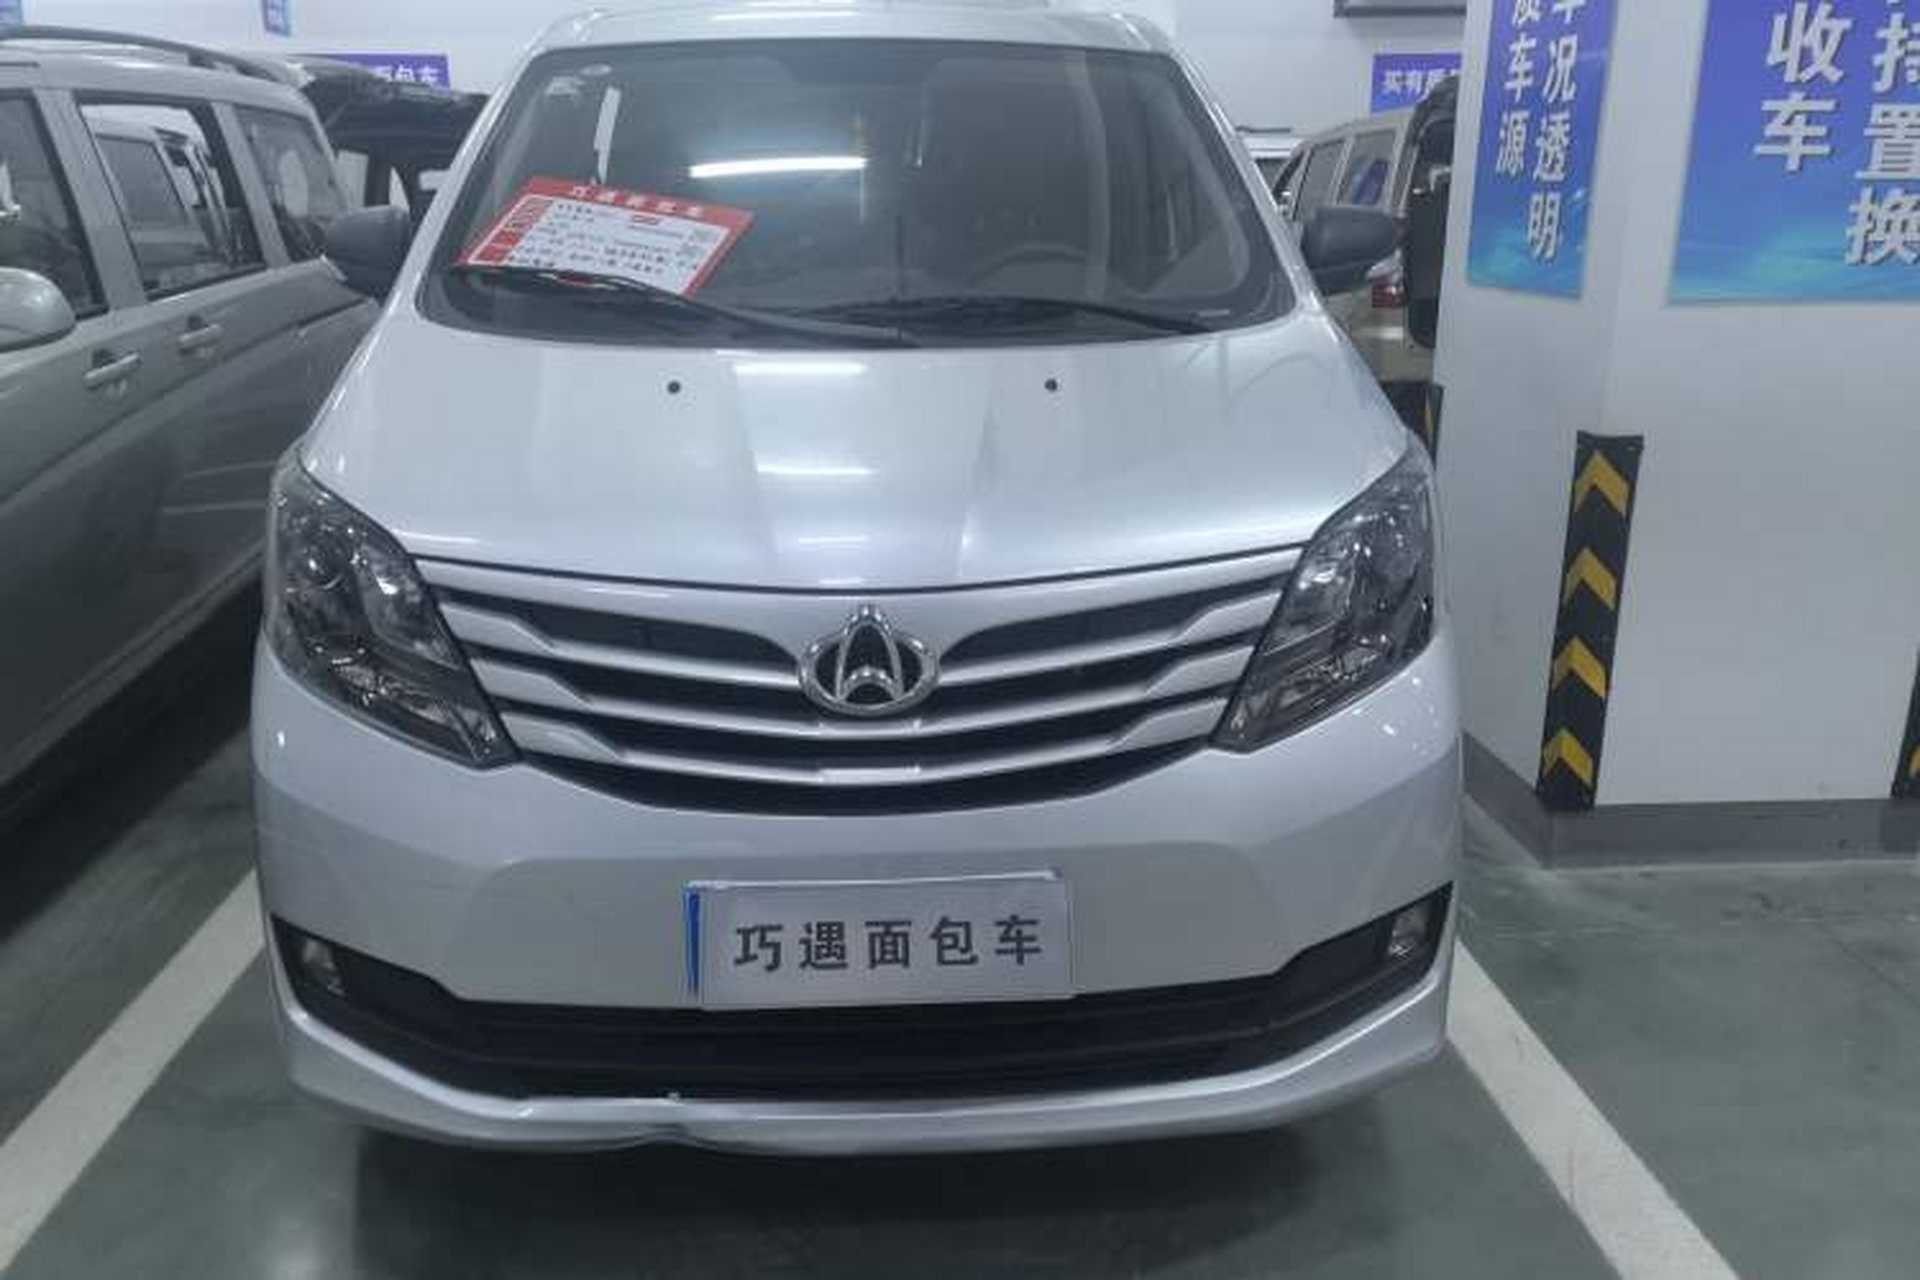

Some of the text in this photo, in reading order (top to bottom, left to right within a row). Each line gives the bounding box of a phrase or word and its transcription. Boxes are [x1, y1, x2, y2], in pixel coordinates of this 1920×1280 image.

[1753, 0, 1853, 173] 收车
[1845, 0, 1920, 266] 持置换
[734, 914, 1042, 973] 巧遇面包车
